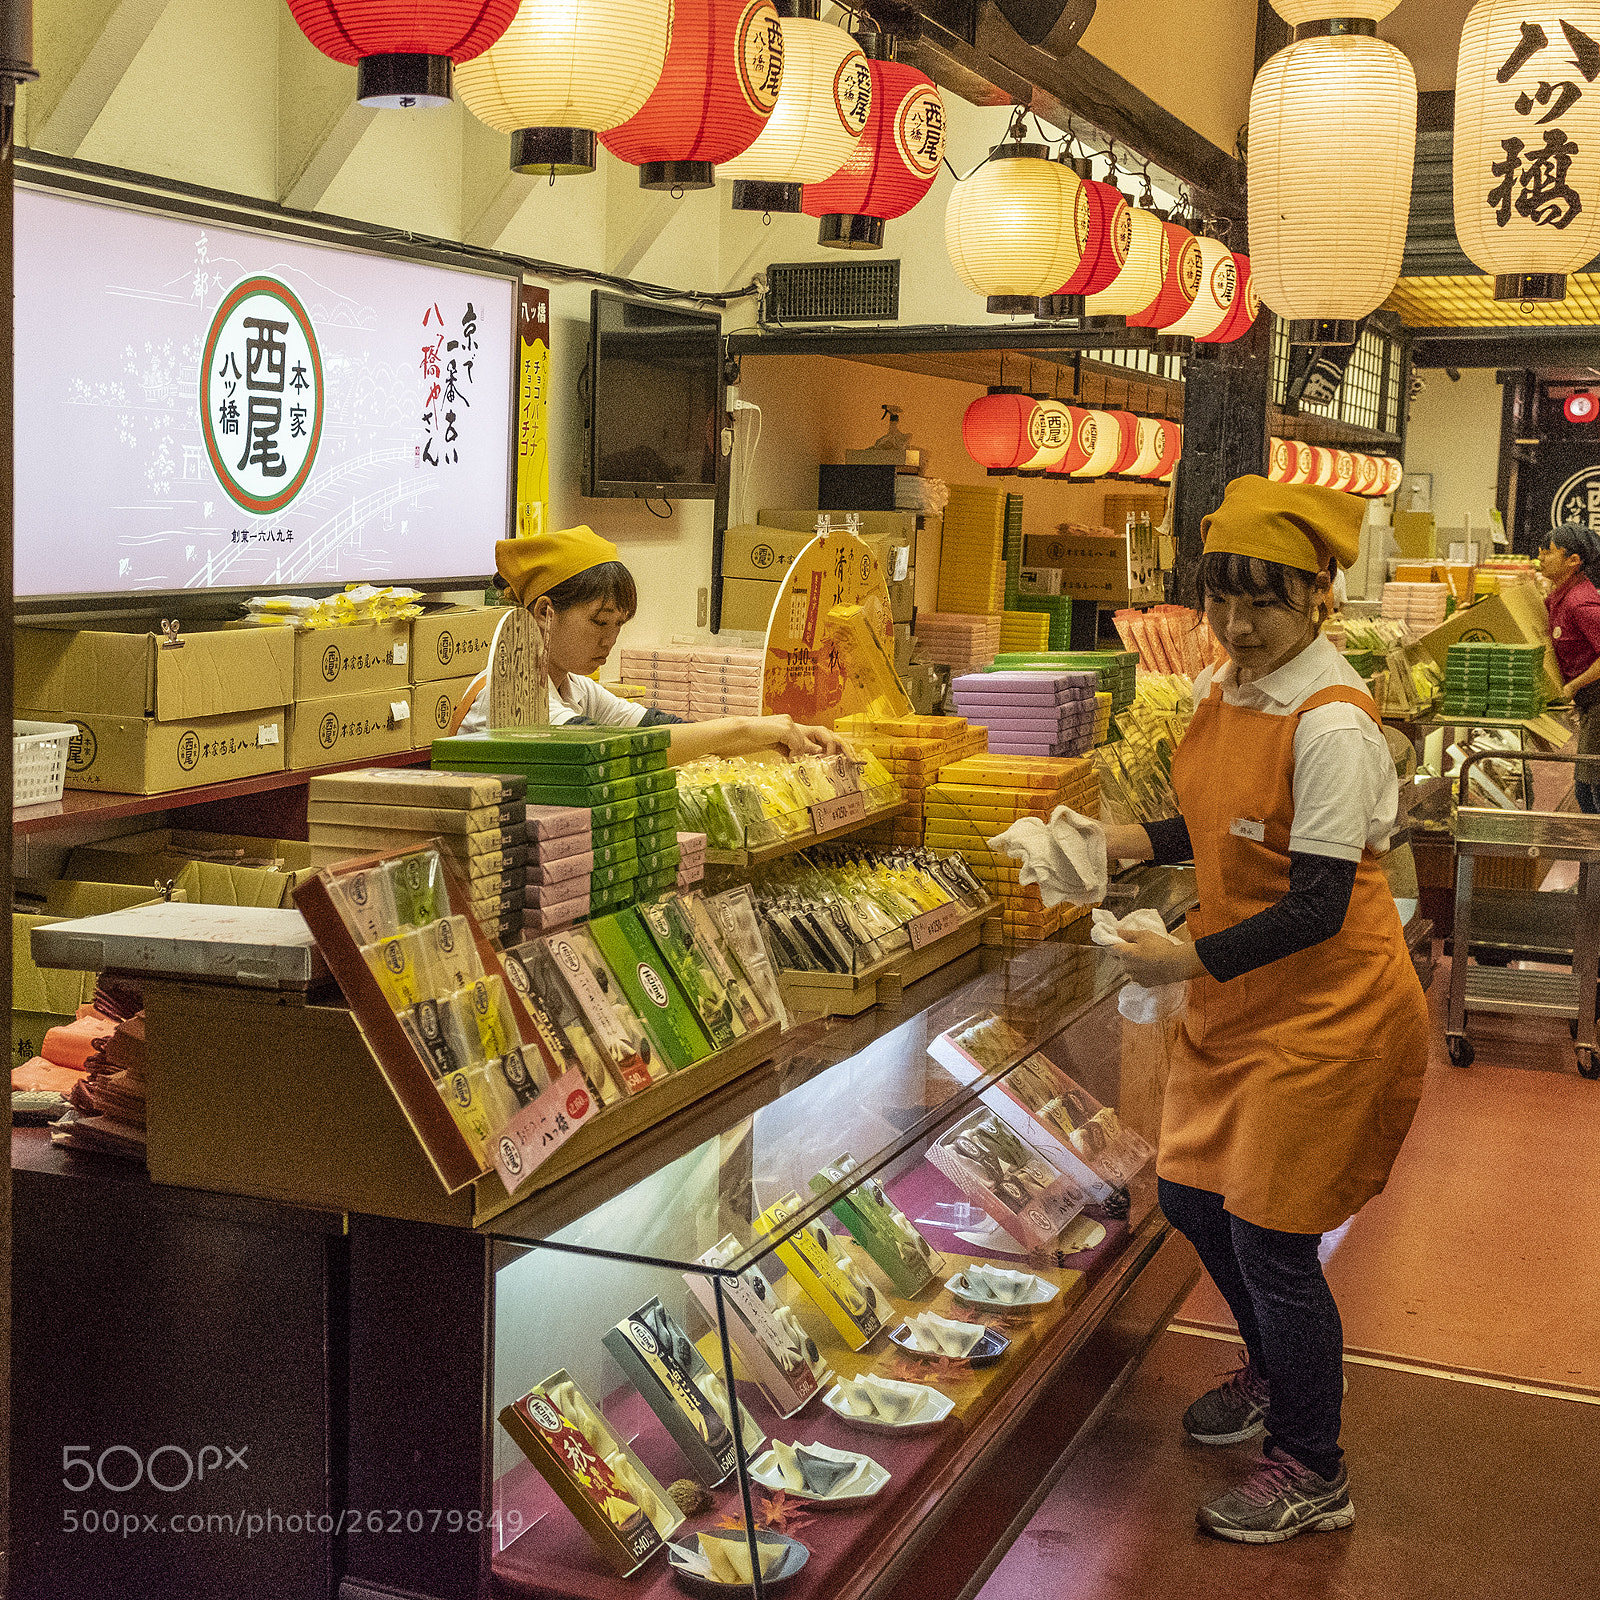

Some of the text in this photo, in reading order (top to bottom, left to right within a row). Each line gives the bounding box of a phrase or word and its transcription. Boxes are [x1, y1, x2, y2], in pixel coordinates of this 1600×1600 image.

[917, 100, 943, 162] 西尾
[191, 230, 210, 312] 京都
[237, 316, 289, 477] 西尾
[290, 359, 309, 438] 本家
[520, 359, 532, 456] チョコイチゴ
[529, 360, 542, 456] チョコバナナ
[1046, 415, 1062, 443] 西尾
[231, 528, 294, 543] 創業一六八九年
[832, 546, 847, 605] 清水
[183, 738, 193, 765] 西尾
[532, 1401, 557, 1428] 西尾
